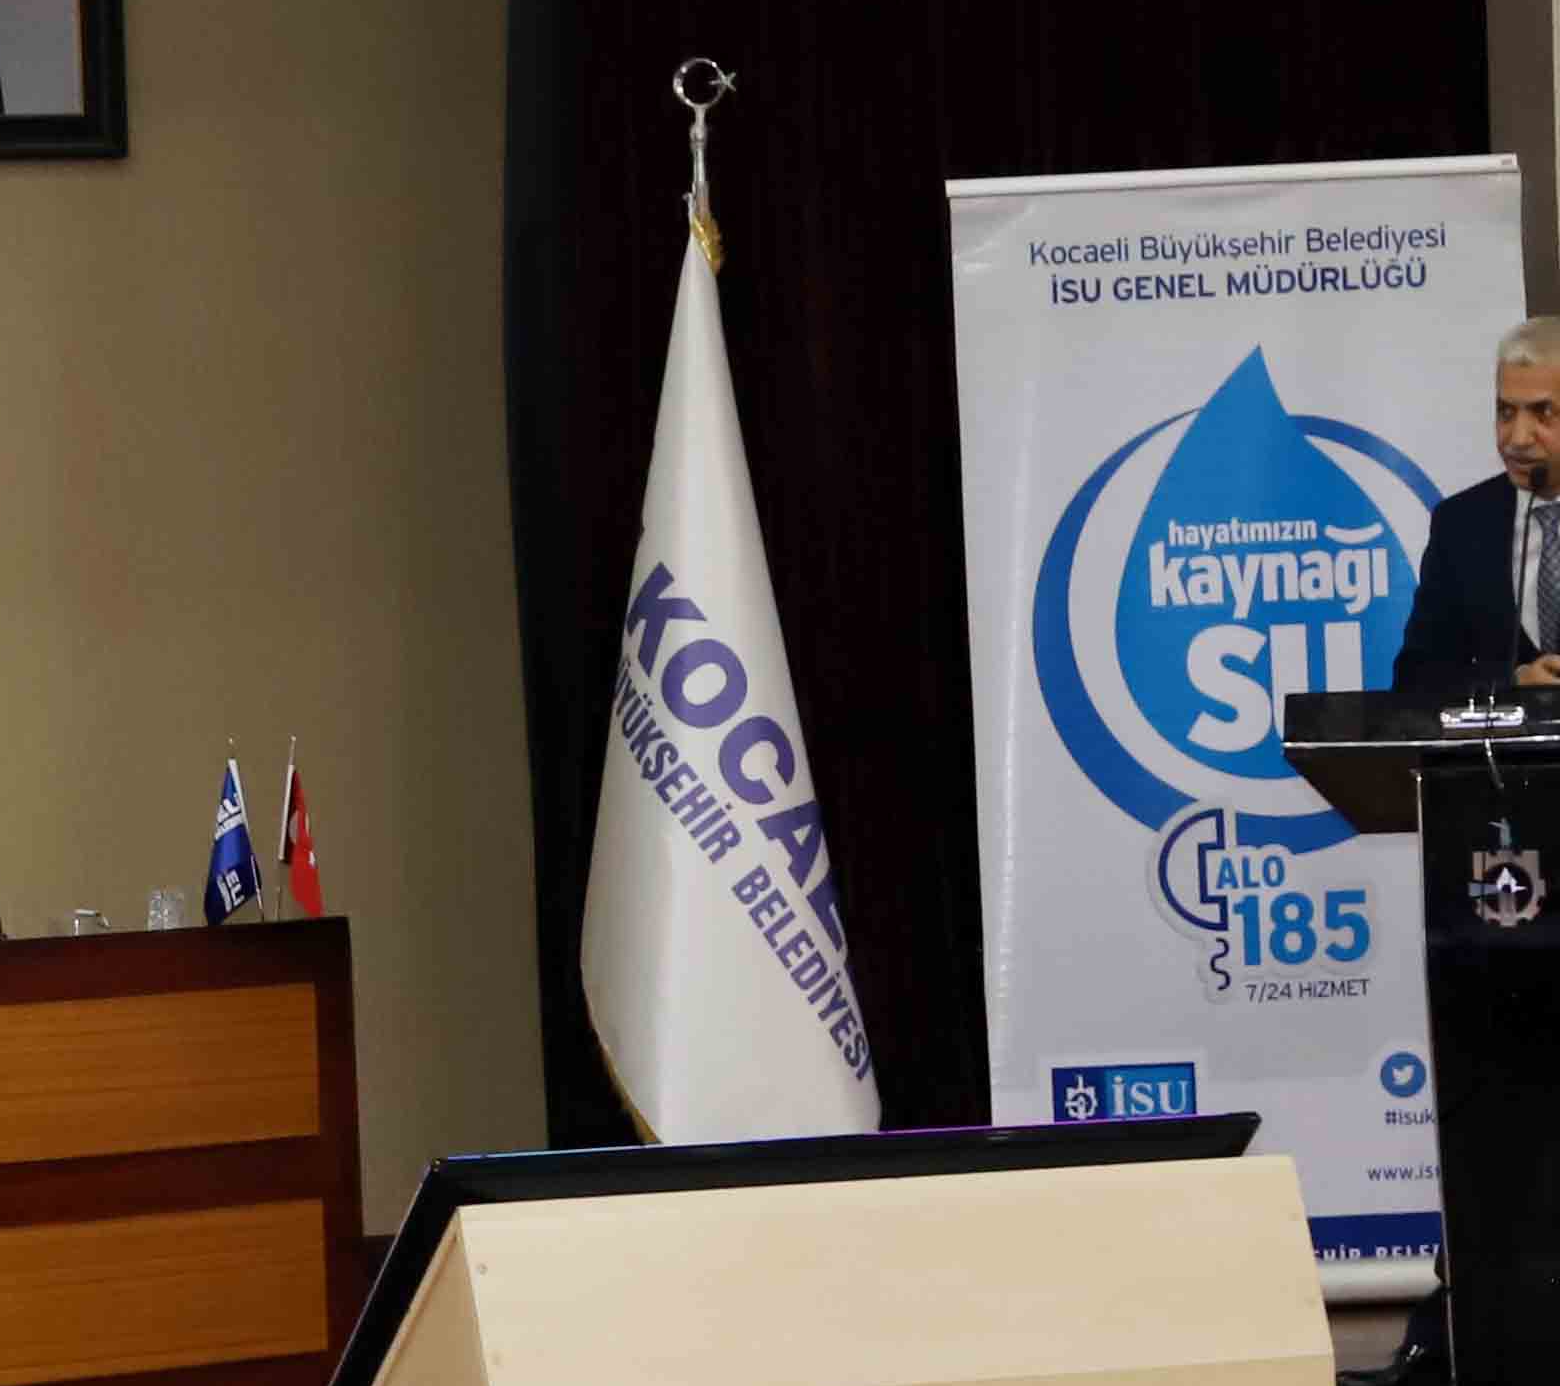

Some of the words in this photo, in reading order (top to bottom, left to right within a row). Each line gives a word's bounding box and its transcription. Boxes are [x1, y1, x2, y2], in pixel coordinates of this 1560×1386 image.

[1029, 235, 1129, 266] Kocaeli
[1140, 229, 1295, 265] Büyükşehir
[1305, 222, 1447, 255] Belediyesi
[1051, 273, 1102, 304] İSU
[1112, 273, 1216, 302] GENEL
[1226, 258, 1427, 297] MÜDÜRLÜĞÜ
[1167, 517, 1318, 550] hayatımızın
[1148, 522, 1390, 620] kaynağı
[1215, 855, 1285, 890] ALO
[1232, 889, 1371, 966] 185
[1244, 982, 1292, 1003] 7/24
[1111, 1074, 1192, 1116] İSU
